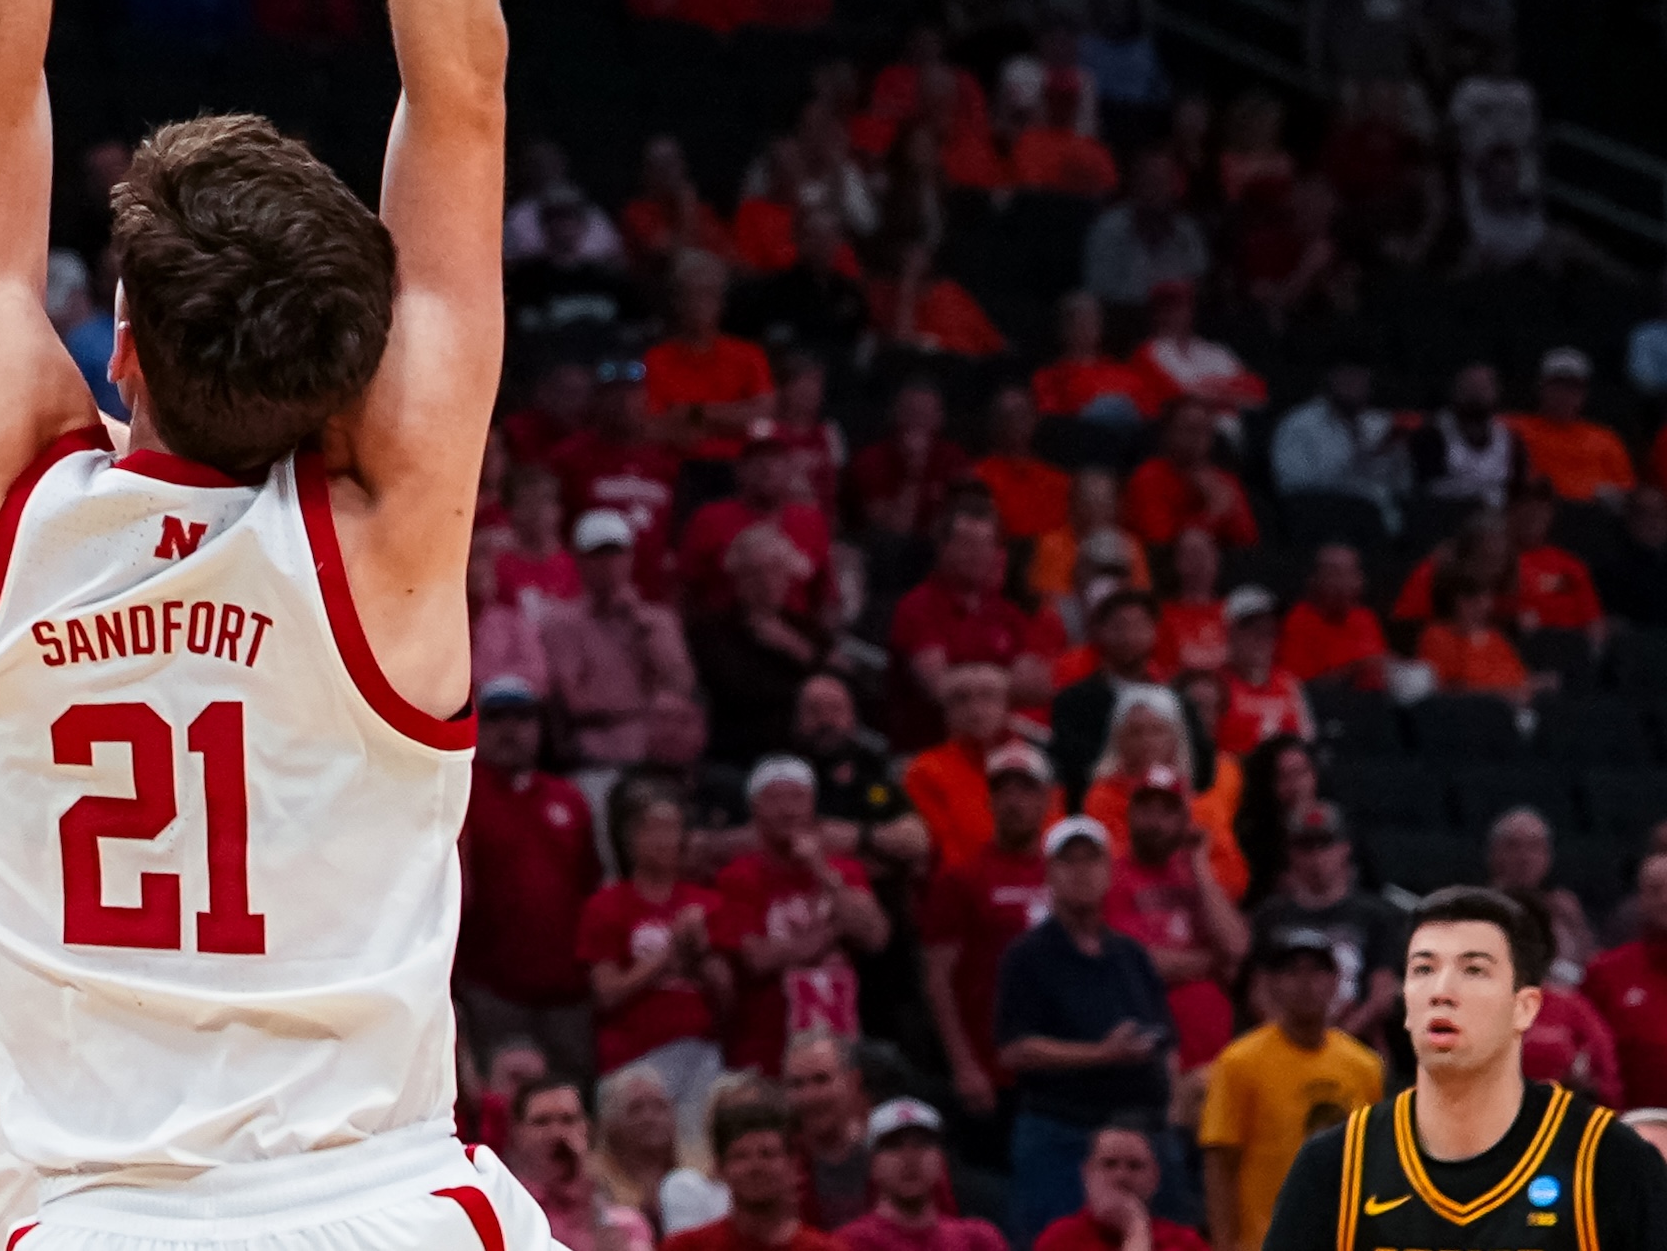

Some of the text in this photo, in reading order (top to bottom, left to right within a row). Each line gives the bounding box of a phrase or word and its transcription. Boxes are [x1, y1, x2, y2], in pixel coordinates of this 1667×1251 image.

[154, 515, 207, 560] N
[31, 600, 274, 668] SANDFORT
[50, 701, 266, 955] 21
